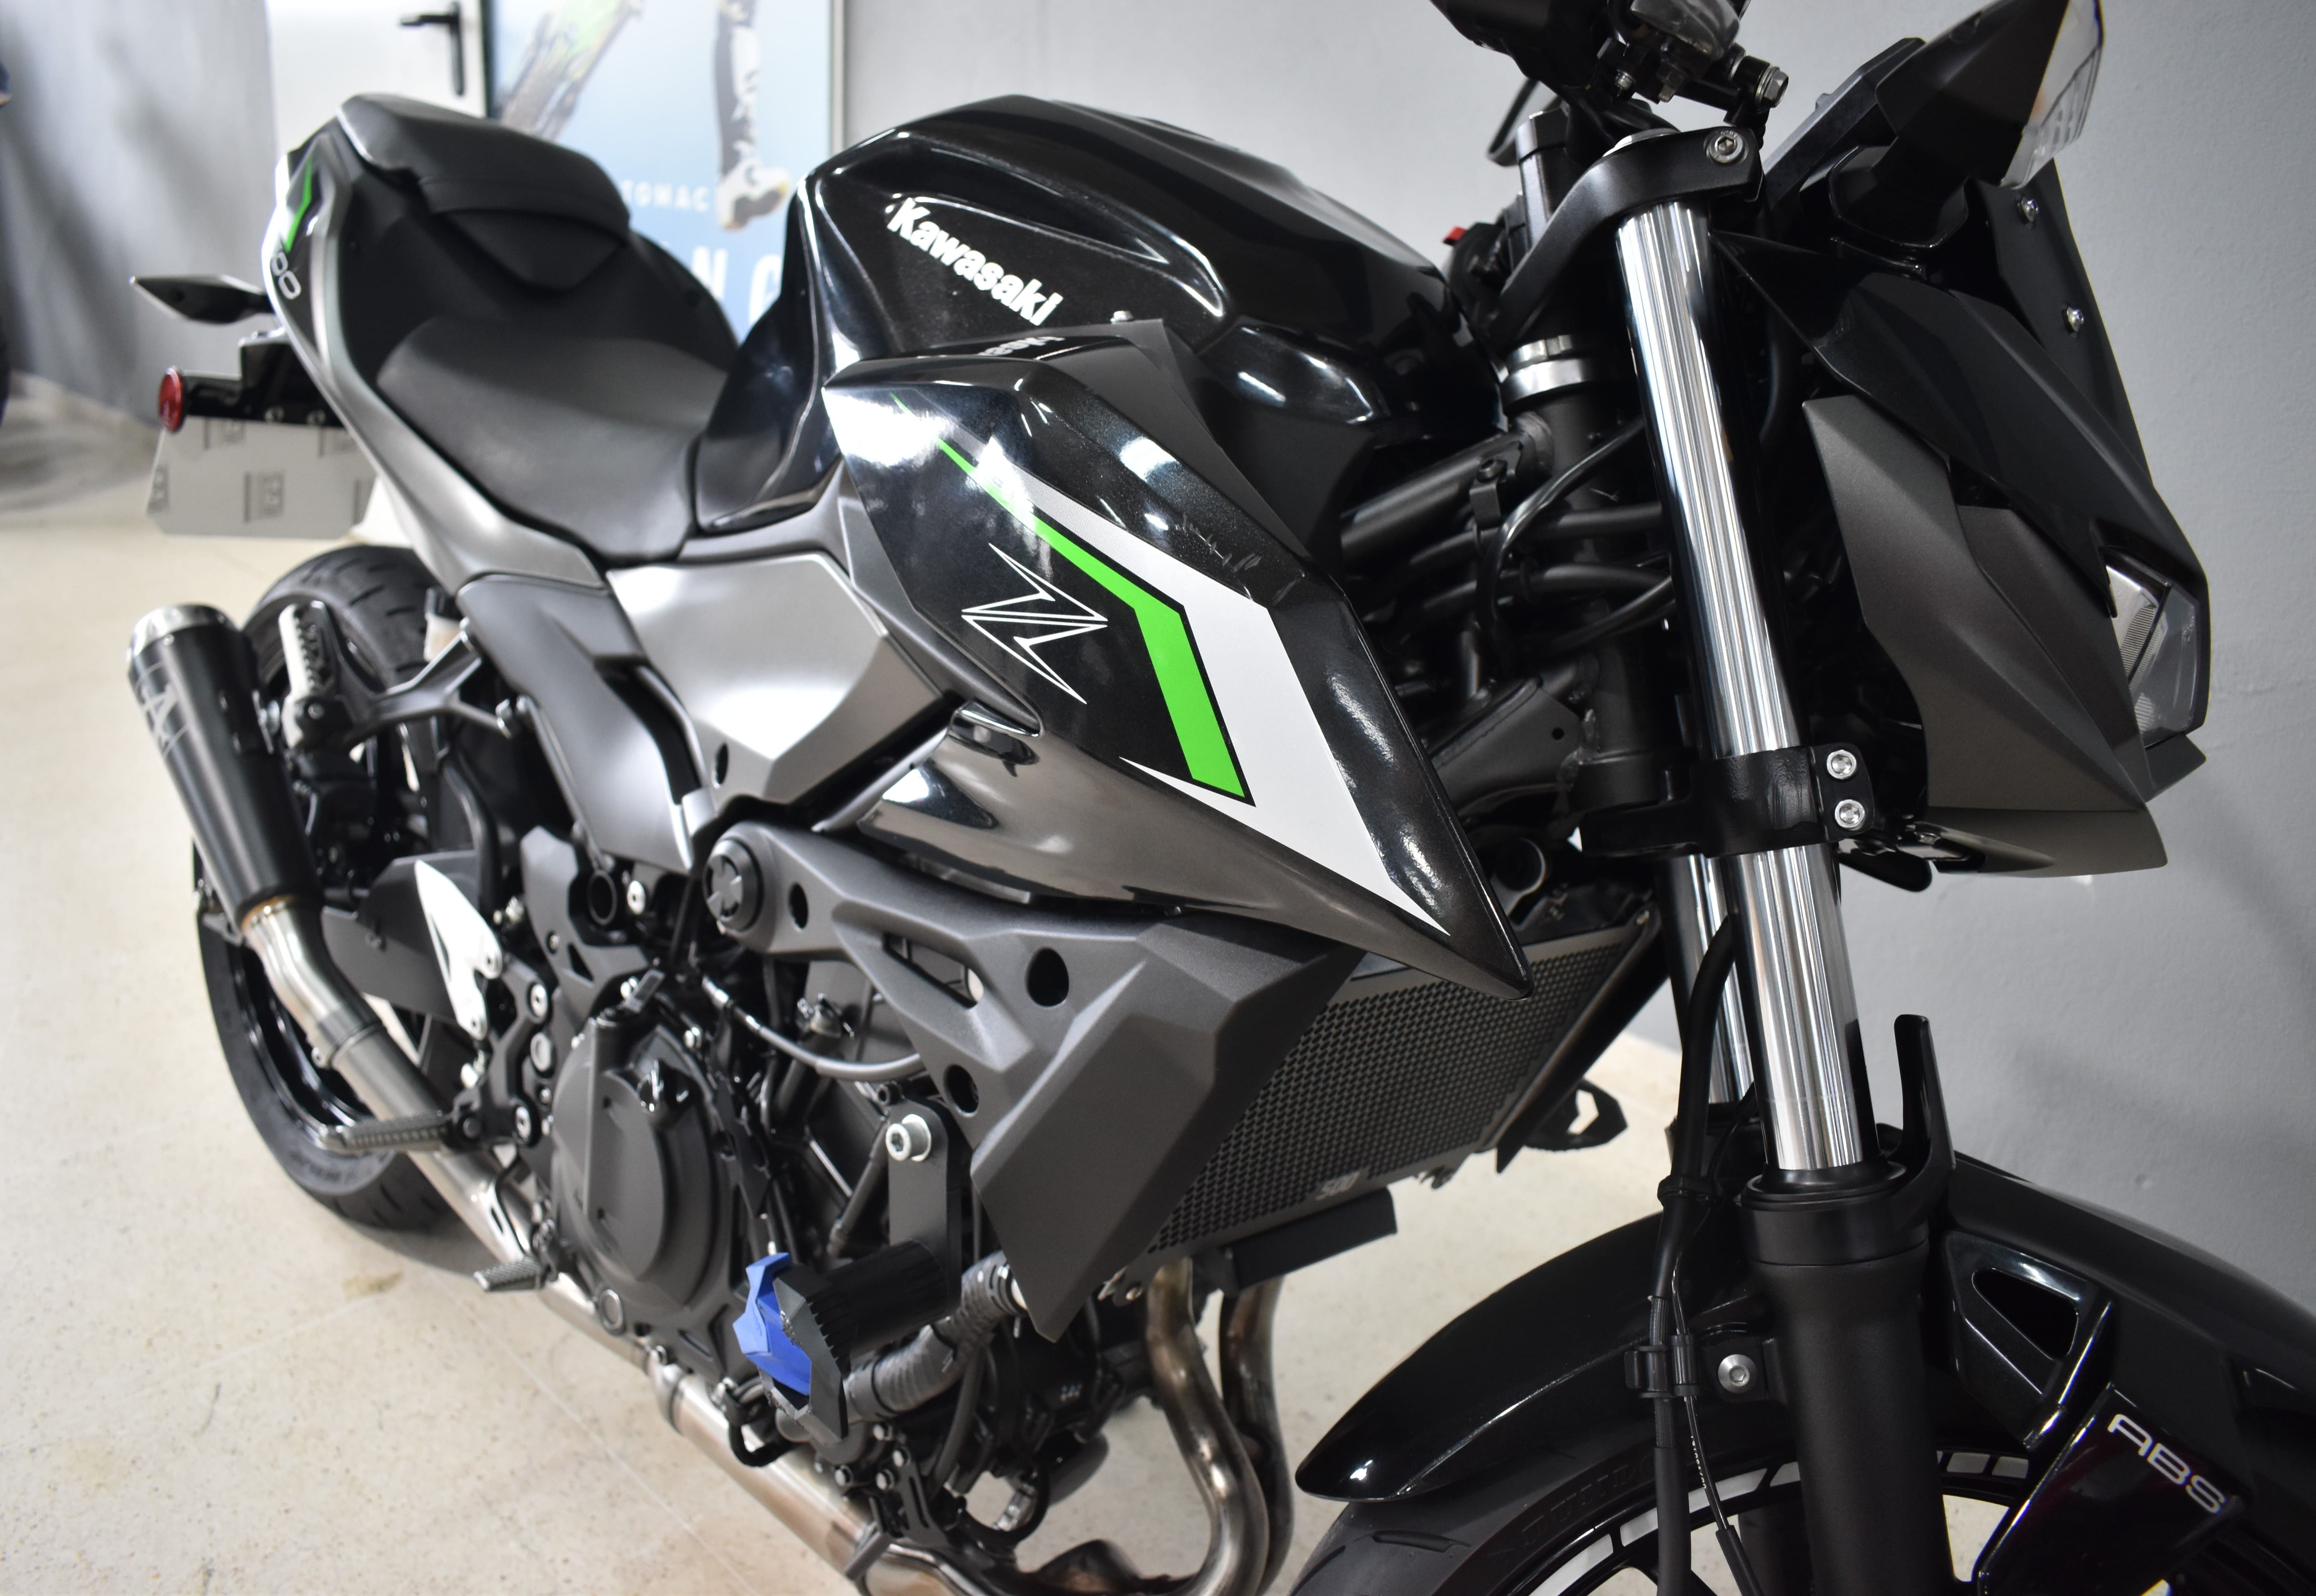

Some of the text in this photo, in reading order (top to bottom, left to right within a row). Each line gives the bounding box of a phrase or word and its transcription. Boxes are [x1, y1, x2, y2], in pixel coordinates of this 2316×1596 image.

[270, 251, 302, 300] 00
[887, 197, 1063, 326] Kawasaki
[1521, 1452, 1654, 1547] DUNLO
[2107, 1414, 2227, 1514] ABS
